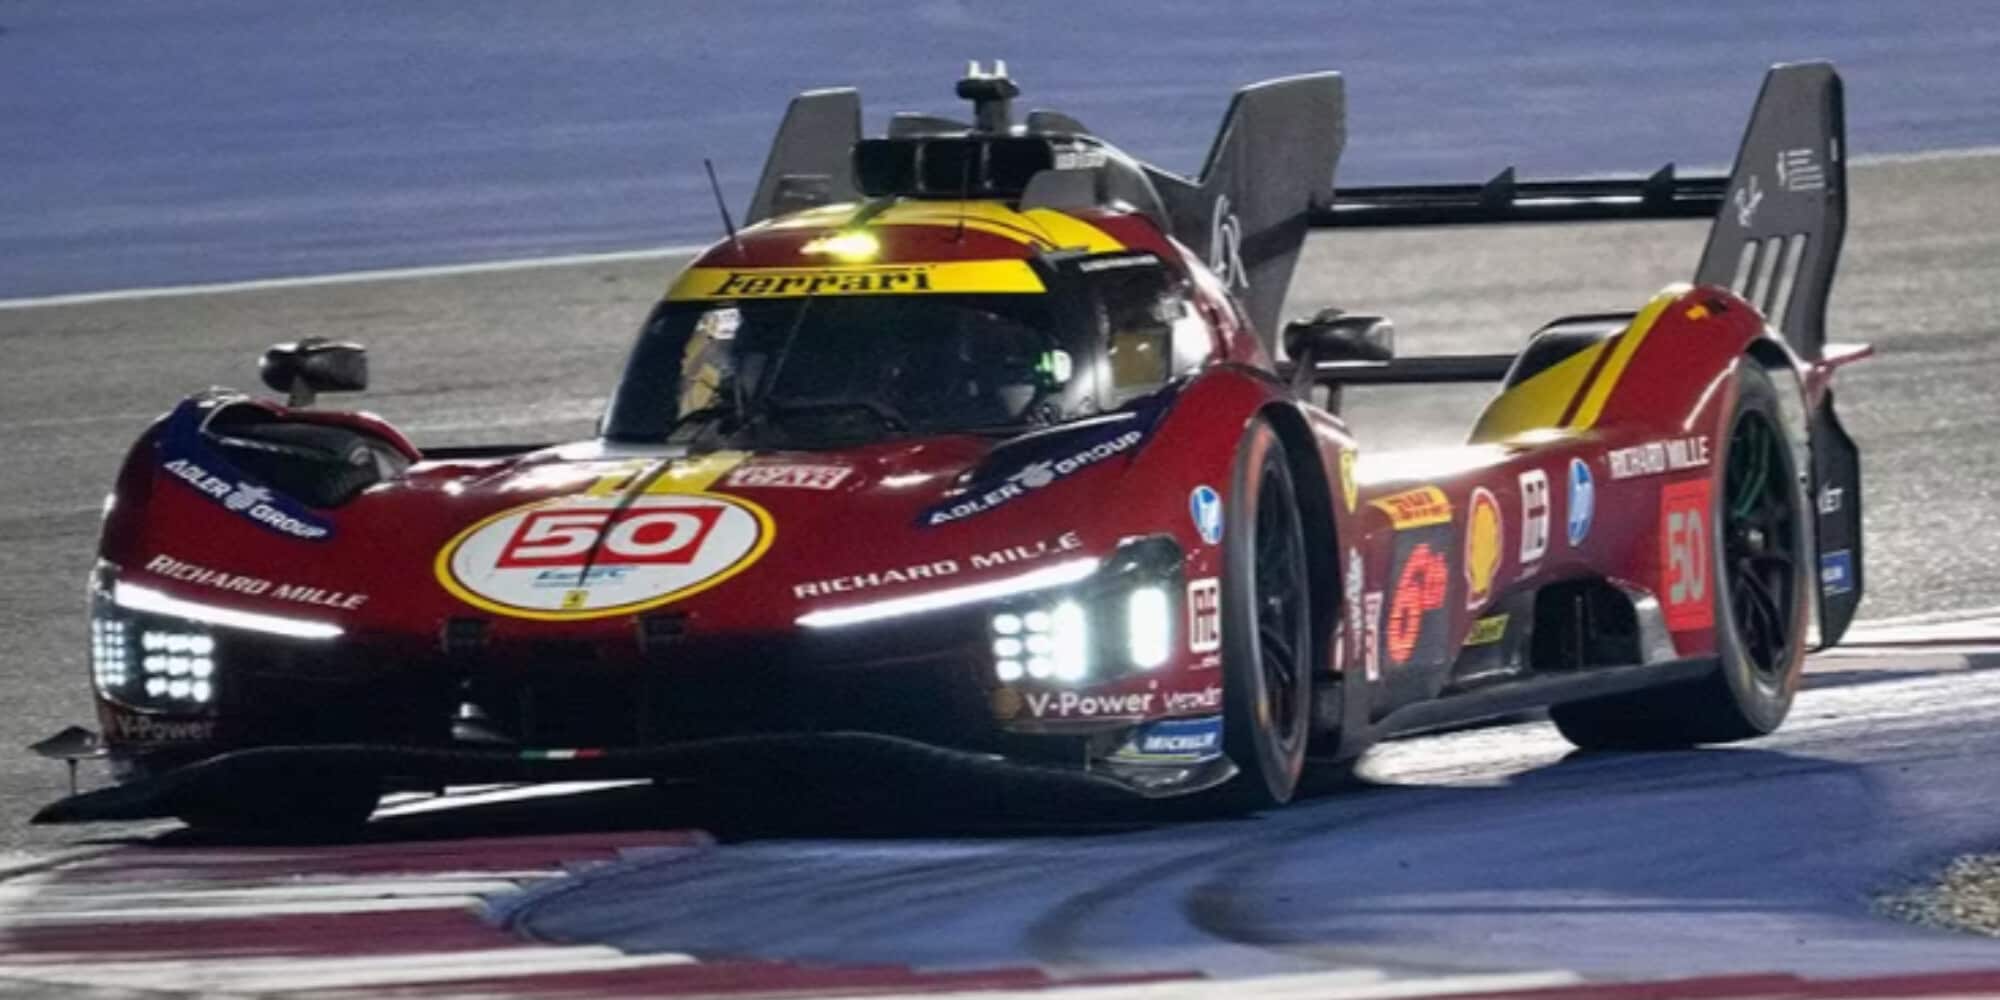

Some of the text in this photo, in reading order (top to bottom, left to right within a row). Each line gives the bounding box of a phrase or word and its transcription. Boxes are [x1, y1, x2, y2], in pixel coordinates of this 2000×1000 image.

[711, 266, 934, 295] Ferrari
[929, 430, 1143, 525] ADLER GROUP
[1608, 436, 1709, 479] RICHARD MILLE
[164, 458, 328, 539] ADLER GROUP
[510, 512, 703, 560] 50
[1668, 508, 1705, 603] 50
[145, 554, 368, 610] RICHARD MILLE
[793, 531, 1084, 600] RICHARD MILLE
[1026, 690, 1155, 717] V-Power
